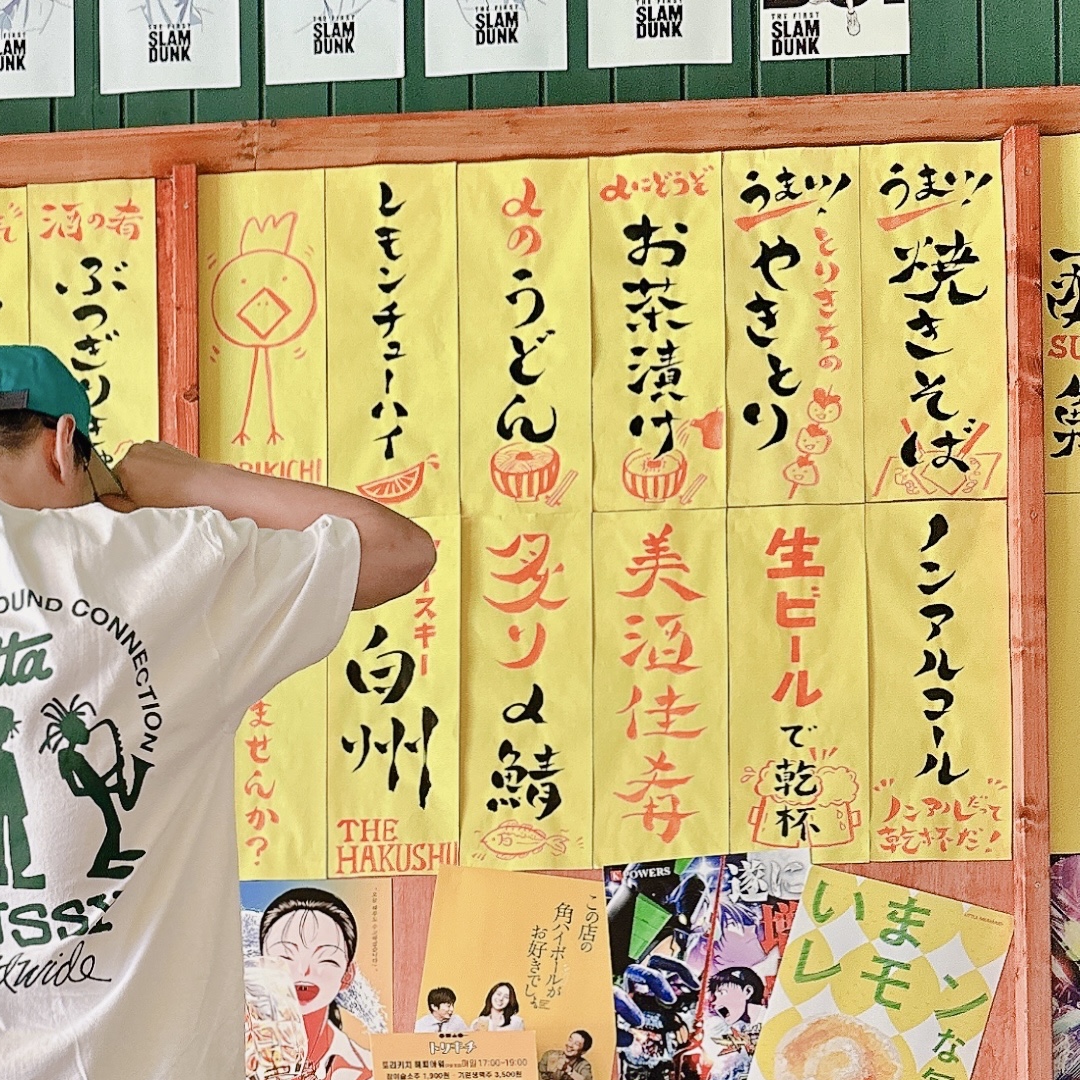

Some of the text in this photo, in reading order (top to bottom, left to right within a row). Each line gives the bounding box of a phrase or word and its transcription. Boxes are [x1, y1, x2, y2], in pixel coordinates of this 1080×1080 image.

[148, 30, 191, 47] SLAM
[313, 22, 355, 39] SLAM
[475, 12, 518, 29] SLAM
[476, 28, 518, 45] DUNK
[636, 5, 683, 22] SLAM
[636, 21, 683, 39] DUNK
[771, 19, 820, 39] SLAM
[149, 46, 191, 62] DUNK
[314, 37, 355, 55] DUNK
[772, 38, 820, 56] DUNK
[371, 182, 408, 460] レモンチューハイ
[813, 227, 842, 372] とりきちの
[622, 214, 693, 460] お茶漬け
[742, 235, 802, 450] やきとり
[888, 229, 988, 473] 焼きそば
[914, 513, 970, 785] ノンアルコール
[71, 599, 162, 752] CONNECTION
[765, 527, 825, 842] 生ビールで乾杯
[341, 625, 439, 809] 白州
[337, 819, 398, 843] THE
[727, 859, 804, 903] 遂に
[578, 895, 599, 953] この店の
[812, 880, 932, 948] いま
[546, 902, 574, 998] 角ハイボールが
[793, 938, 989, 1020] レモン
[429, 1040, 477, 1055] トリキチ
